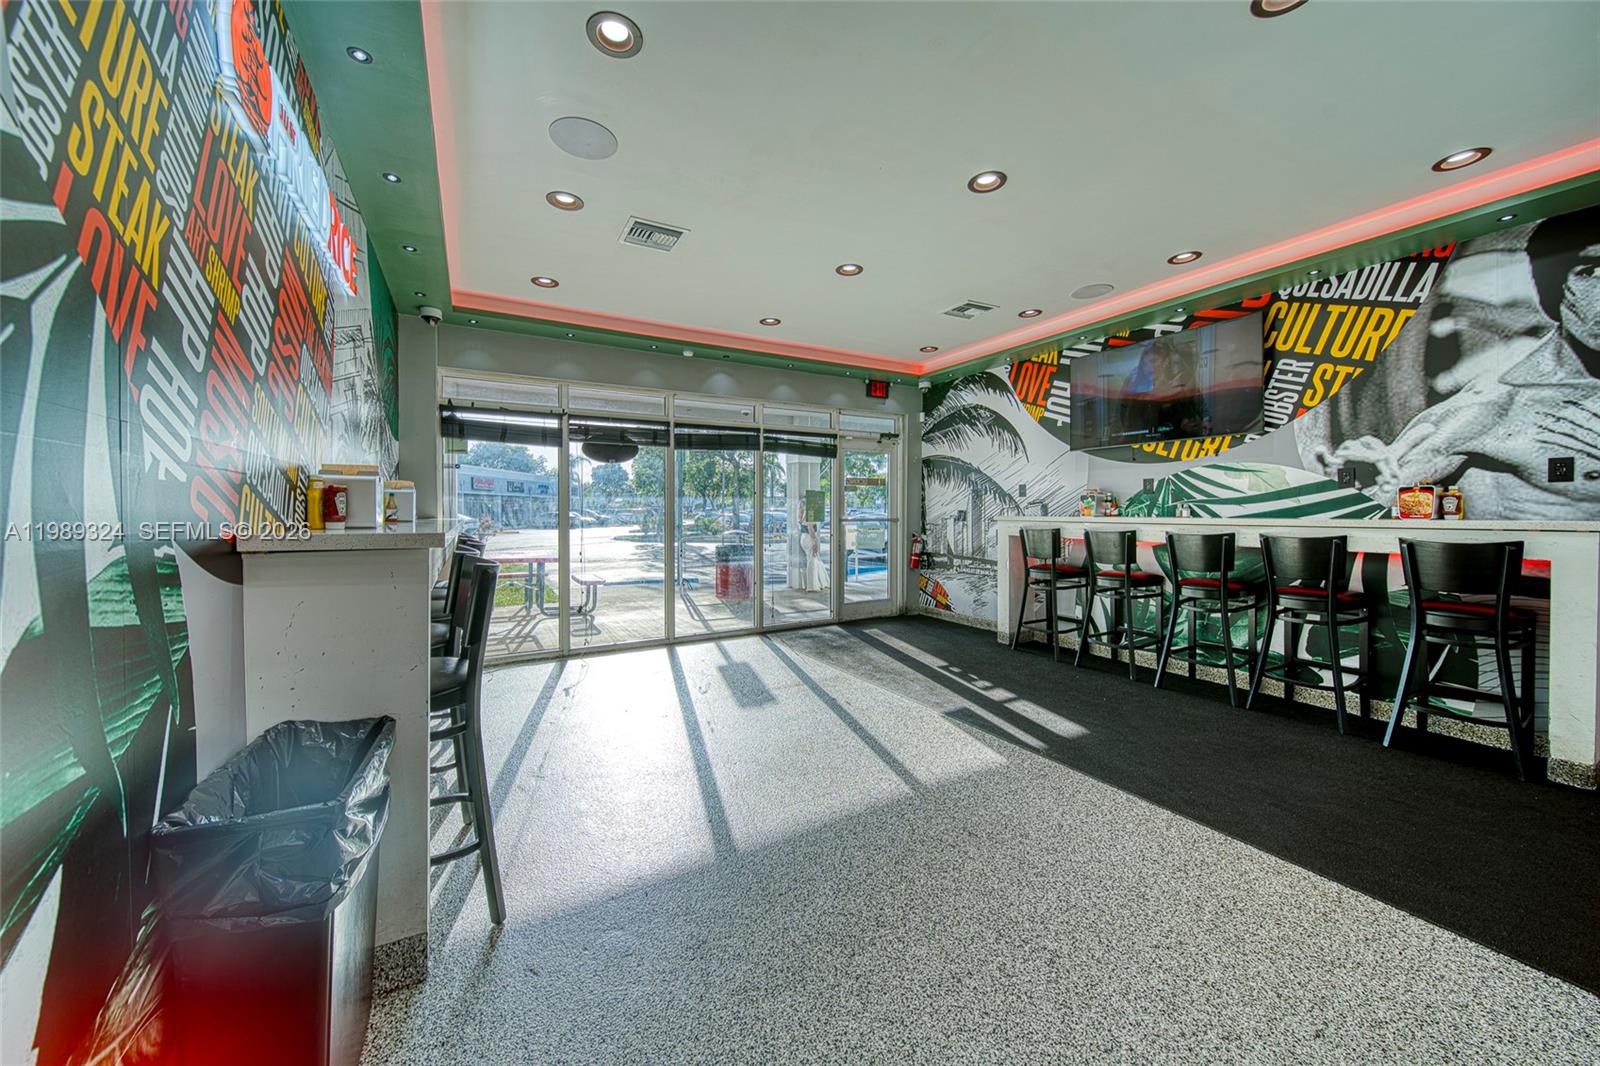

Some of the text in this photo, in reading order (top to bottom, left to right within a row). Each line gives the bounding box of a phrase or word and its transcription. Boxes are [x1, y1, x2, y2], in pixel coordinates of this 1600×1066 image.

[67, 80, 170, 290] STEAK
[155, 94, 199, 231] SOUTH
[193, 127, 252, 295] LOVE
[184, 207, 208, 269] ART
[205, 244, 241, 326] SHRIMP
[254, 178, 284, 289] HIP
[328, 187, 358, 297] RICE
[161, 225, 216, 373] HIP
[240, 252, 276, 377] HOP
[268, 246, 309, 424] MUSIC
[190, 309, 255, 544] MUSIC
[1302, 363, 1364, 408] ST
[246, 429, 295, 527] QUESADILLA
